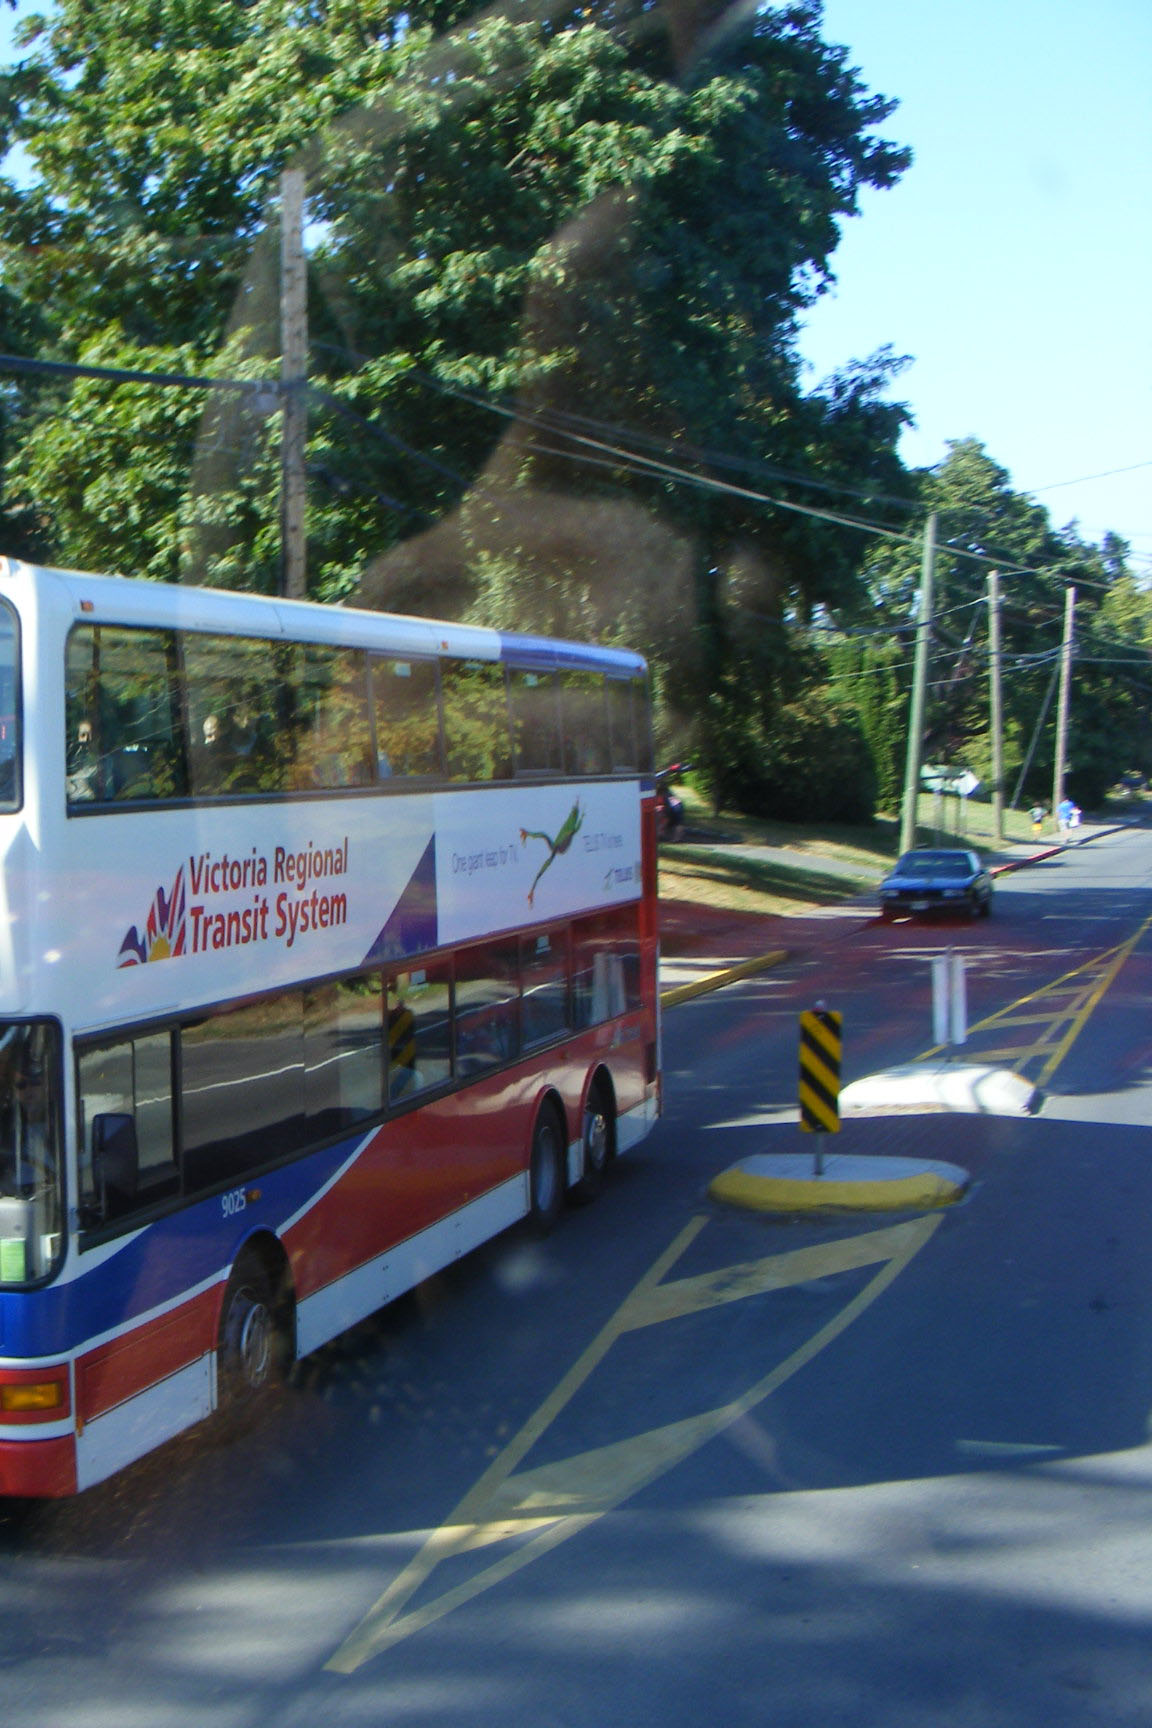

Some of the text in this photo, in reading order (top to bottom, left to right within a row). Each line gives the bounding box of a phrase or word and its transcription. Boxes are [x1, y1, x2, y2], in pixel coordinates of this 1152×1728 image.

[190, 836, 348, 895] Victoria Regional
[190, 889, 347, 953] Transit System
[221, 1187, 246, 1218] 9025
